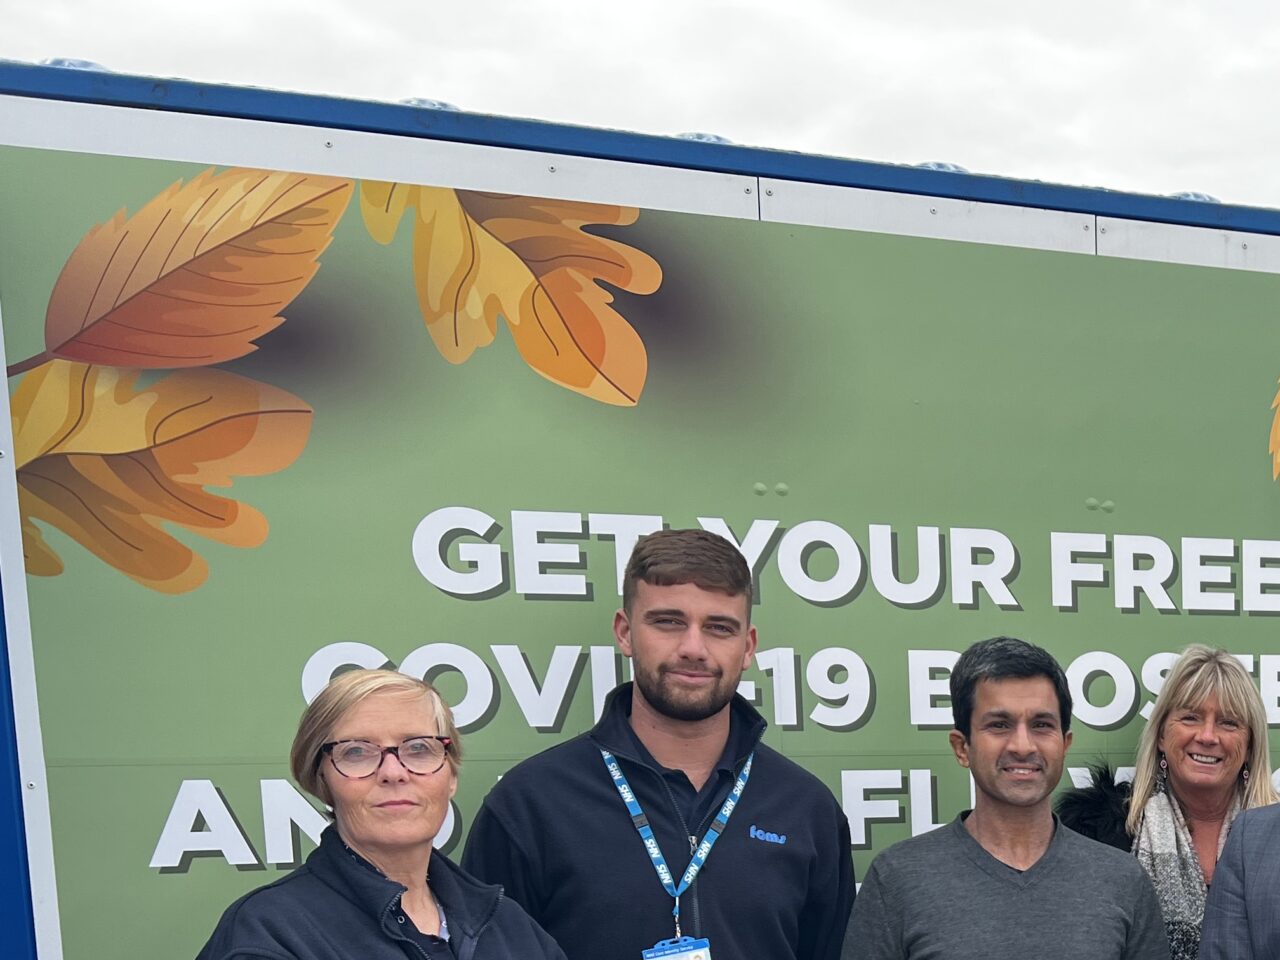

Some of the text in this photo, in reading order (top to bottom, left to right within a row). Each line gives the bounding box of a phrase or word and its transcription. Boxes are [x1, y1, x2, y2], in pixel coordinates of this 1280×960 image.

[411, 507, 663, 597] GET
[733, 778, 746, 797] NHS
[149, 779, 455, 868] AN
[841, 769, 977, 846] FL
[722, 799, 736, 818] NHS
[607, 762, 672, 884] NHS NHS NHS NHS
[697, 840, 711, 860] NHS
[684, 863, 699, 884] NHS
